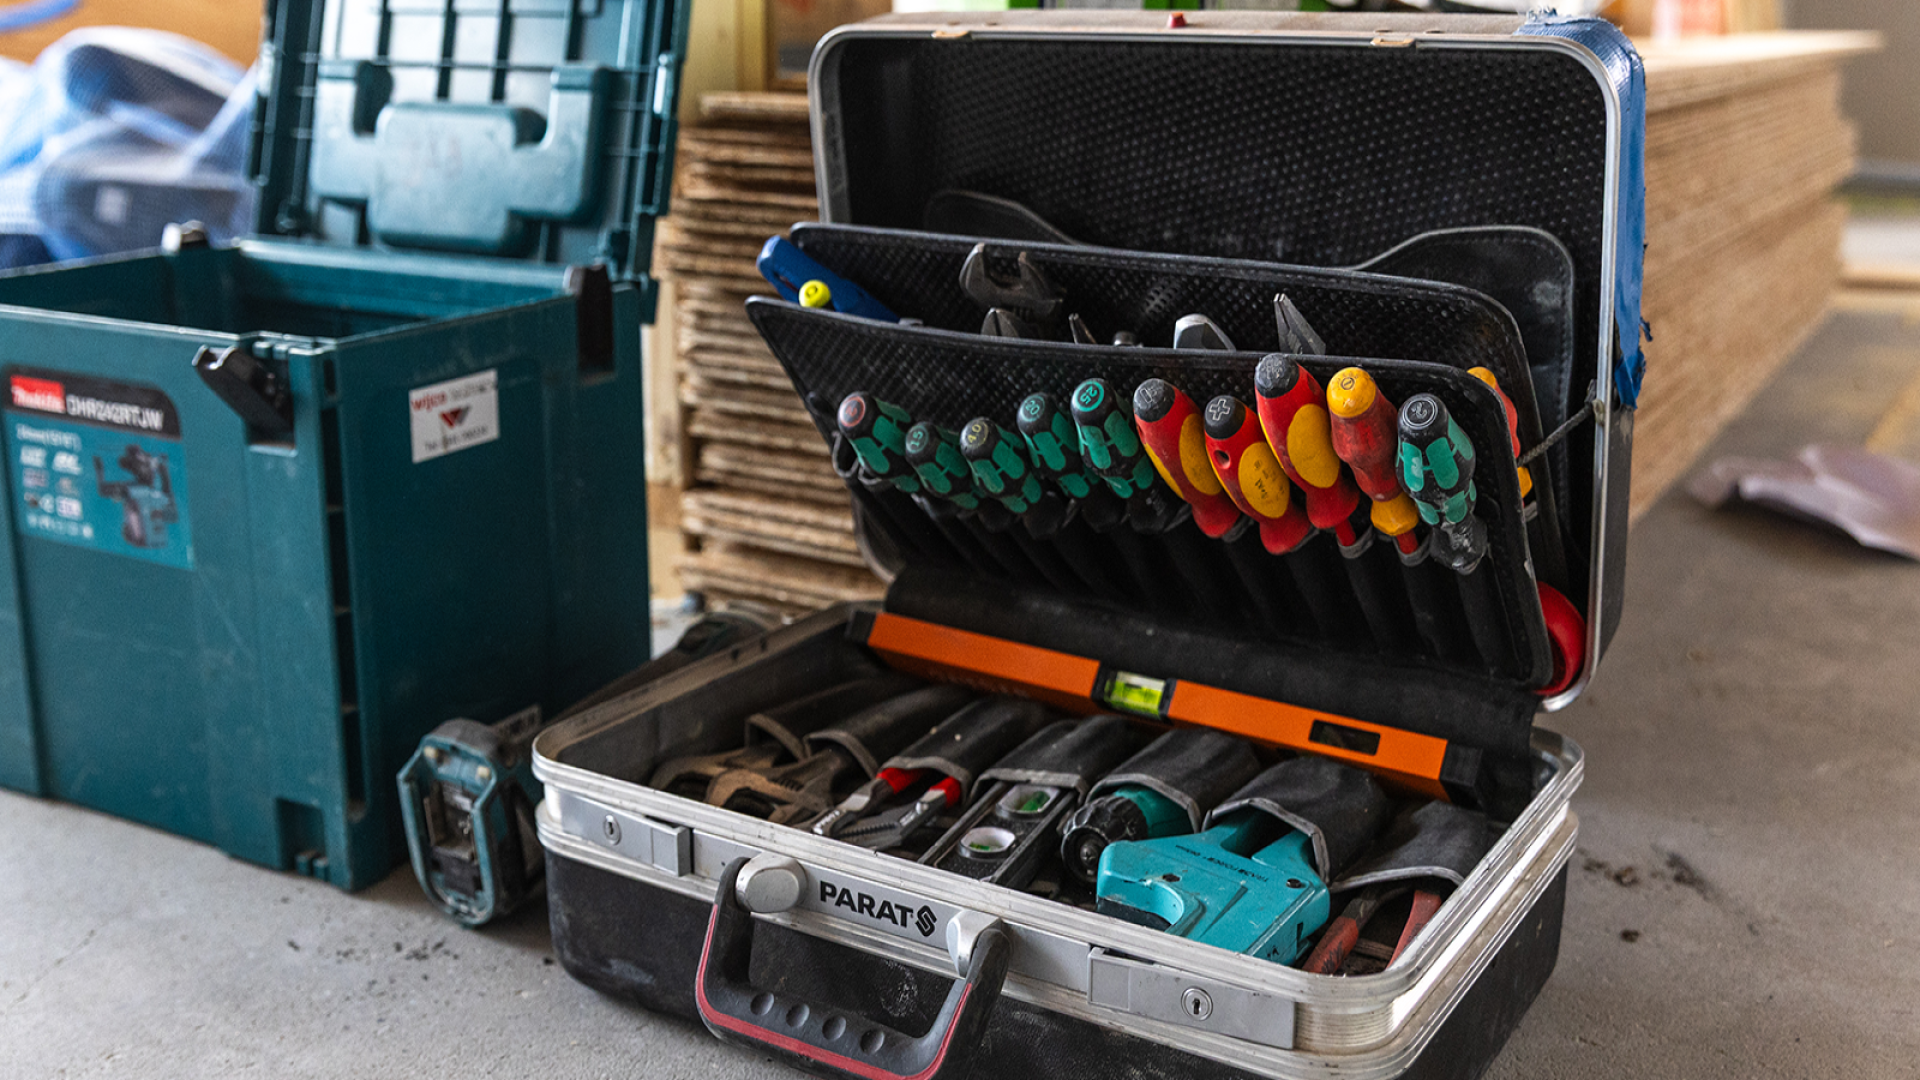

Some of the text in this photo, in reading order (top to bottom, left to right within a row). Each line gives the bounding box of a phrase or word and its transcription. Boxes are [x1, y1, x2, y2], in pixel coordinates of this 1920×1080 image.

[1080, 386, 1098, 404] 25
[1025, 400, 1040, 415] 20
[910, 431, 924, 447] 15
[820, 880, 914, 929] PARAT
